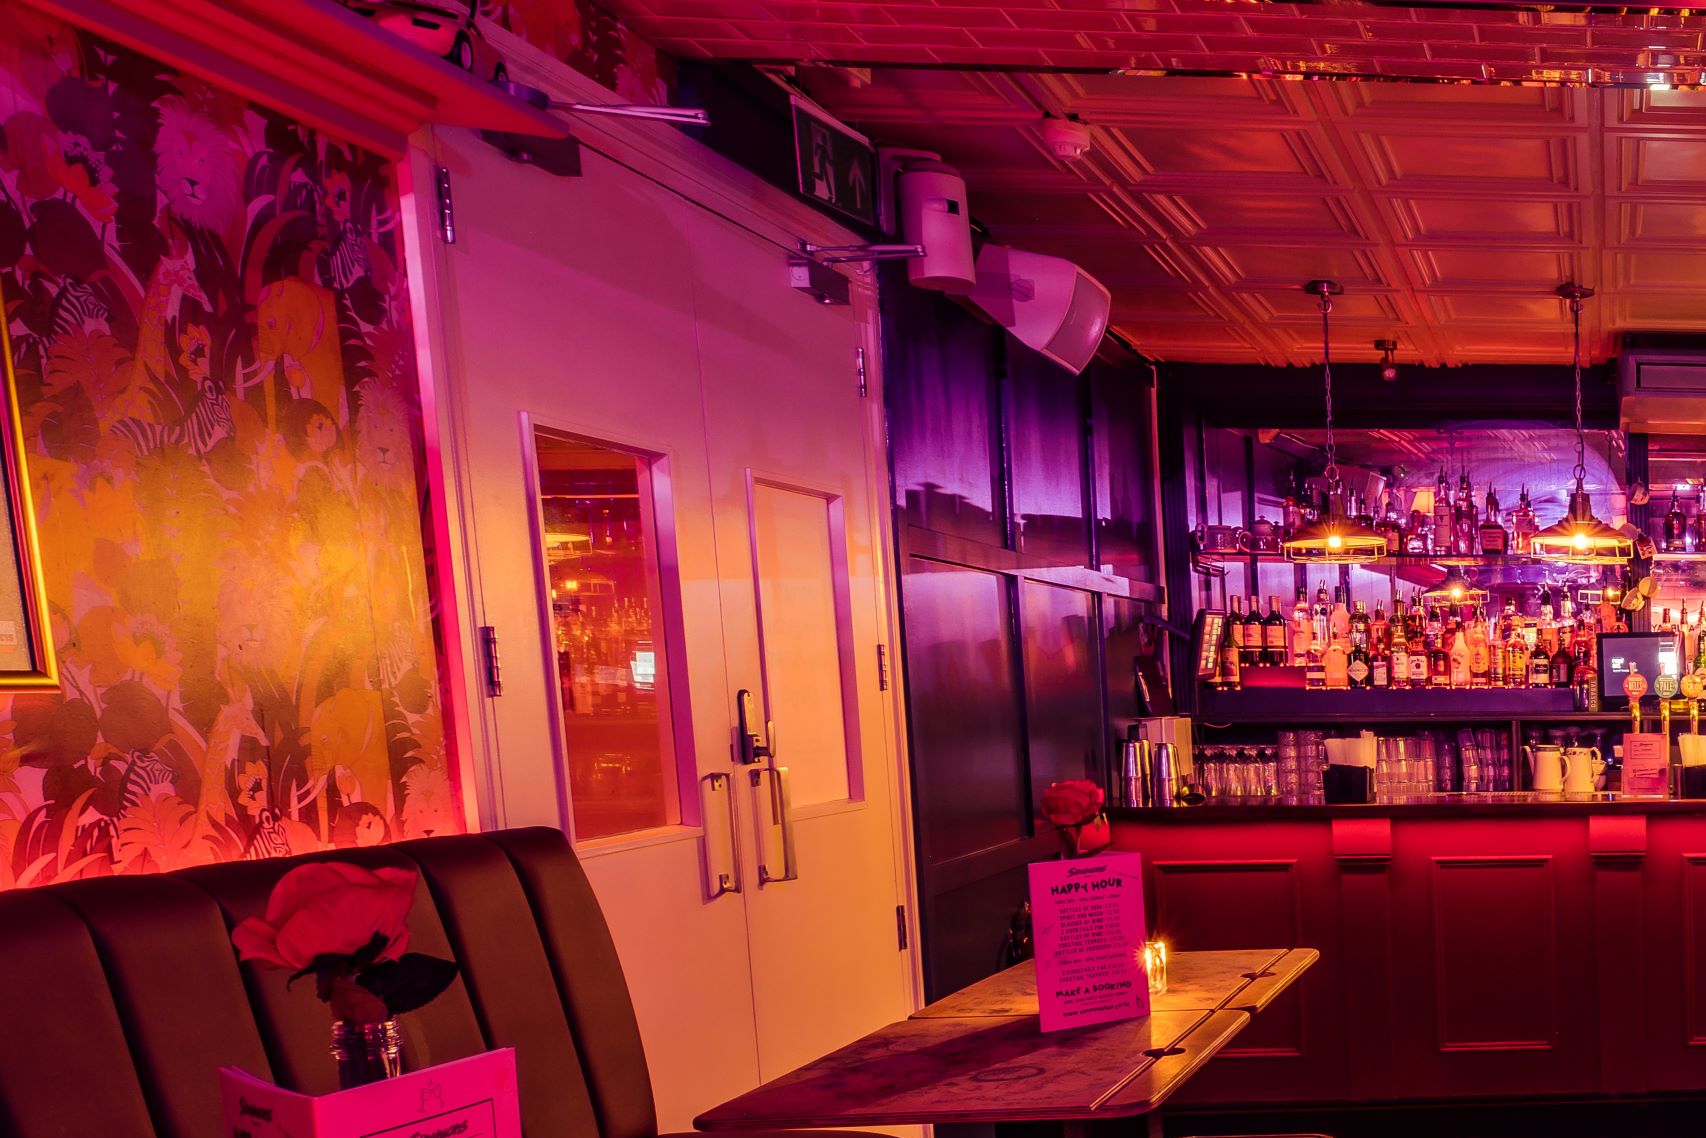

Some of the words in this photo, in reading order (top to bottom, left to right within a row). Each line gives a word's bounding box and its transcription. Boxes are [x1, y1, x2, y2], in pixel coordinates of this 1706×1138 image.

[1051, 882, 1088, 896] HAPPY
[1091, 878, 1122, 890] HOUR
[1055, 987, 1081, 998] MAKE
[1093, 980, 1131, 993] BOOKING
